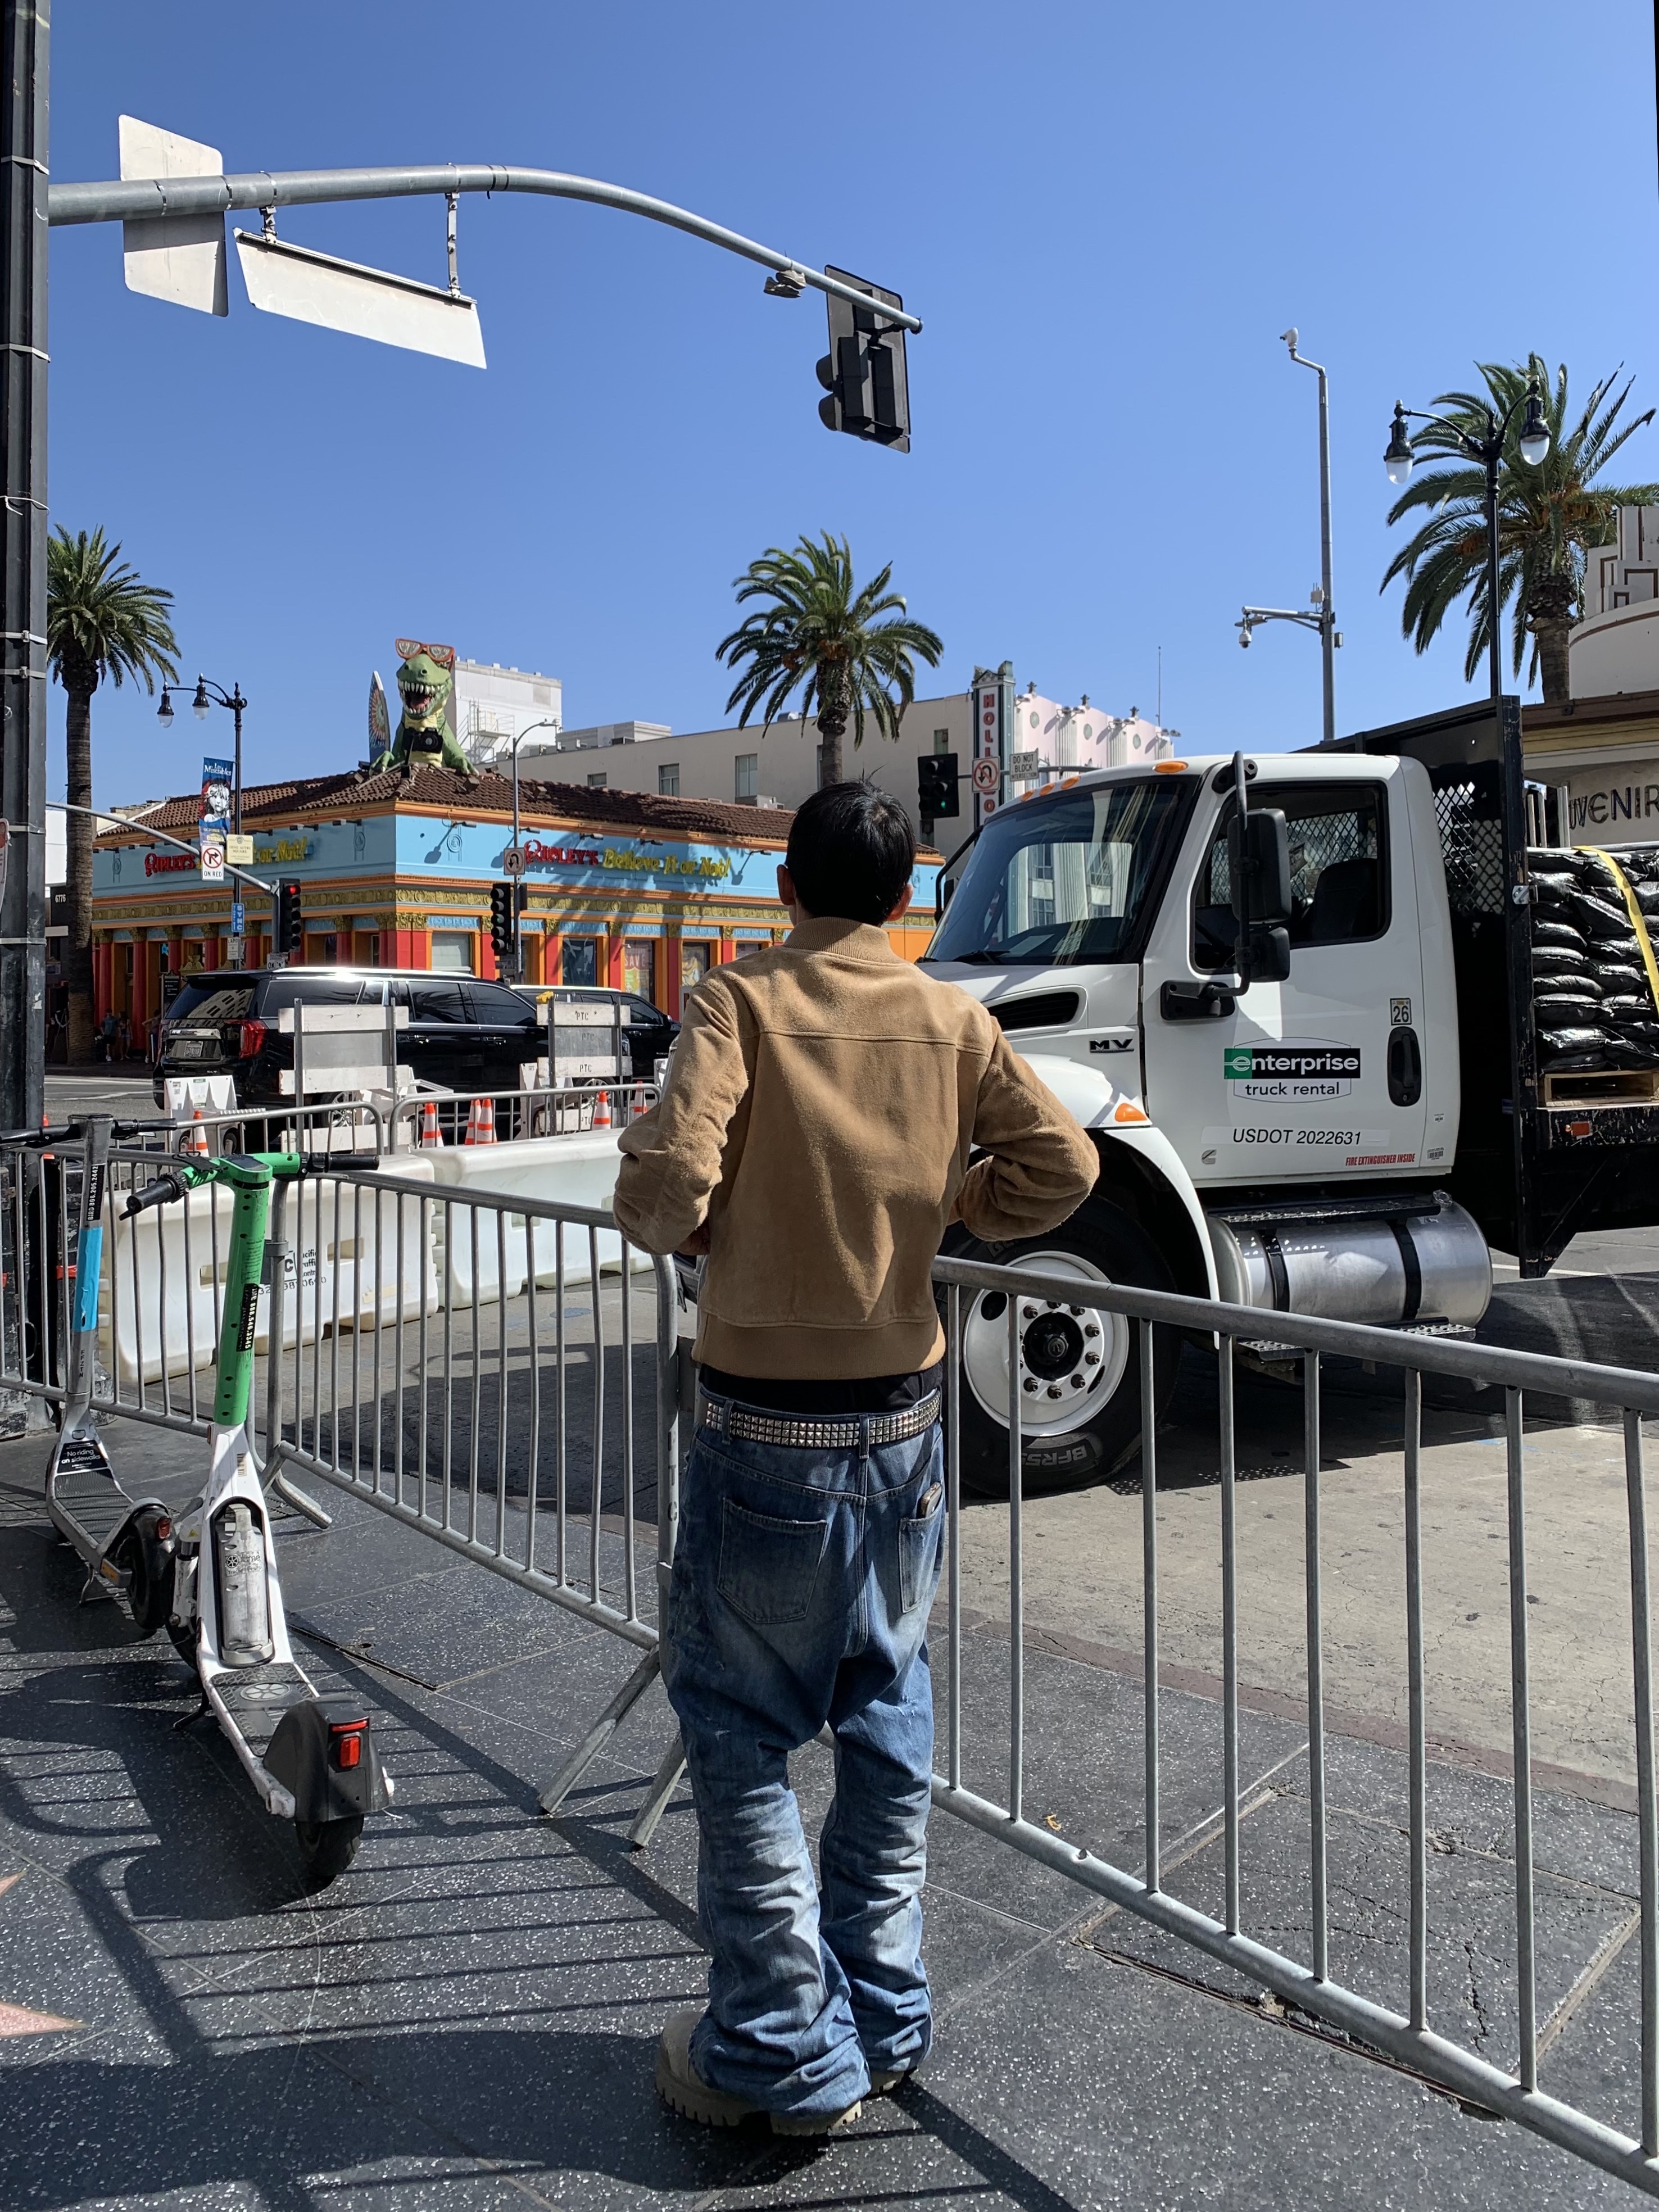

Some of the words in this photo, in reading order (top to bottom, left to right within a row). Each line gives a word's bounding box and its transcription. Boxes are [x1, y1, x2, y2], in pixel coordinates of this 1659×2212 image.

[1013, 756, 1021, 764] DO
[1023, 754, 1034, 762] NOT
[1015, 763, 1033, 773] BLOCK
[602, 847, 660, 872] Believe
[664, 854, 678, 874] It
[679, 860, 697, 874] or
[700, 856, 731, 877] Not!
[55, 894, 66, 903] 6776
[624, 954, 646, 967] SAVE
[576, 1012, 589, 1021] PTC
[1393, 1005, 1409, 1023] 26
[1089, 1039, 1134, 1050] MV
[579, 1064, 592, 1072] PTC
[1232, 1053, 1359, 1075] enterprise
[1245, 1082, 1288, 1095] truck
[1294, 1081, 1339, 1095] rental
[1233, 1128, 1294, 1144] USDOT
[1297, 1131, 1361, 1145] 2022631
[1345, 1157, 1358, 1166] FIRE
[1358, 1154, 1397, 1166] EXTINGUISHER
[1397, 1153, 1416, 1163] INSIDE
[245, 1302, 257, 1349] 888.546.3345
[71, 1454, 101, 1463] sidewalks
